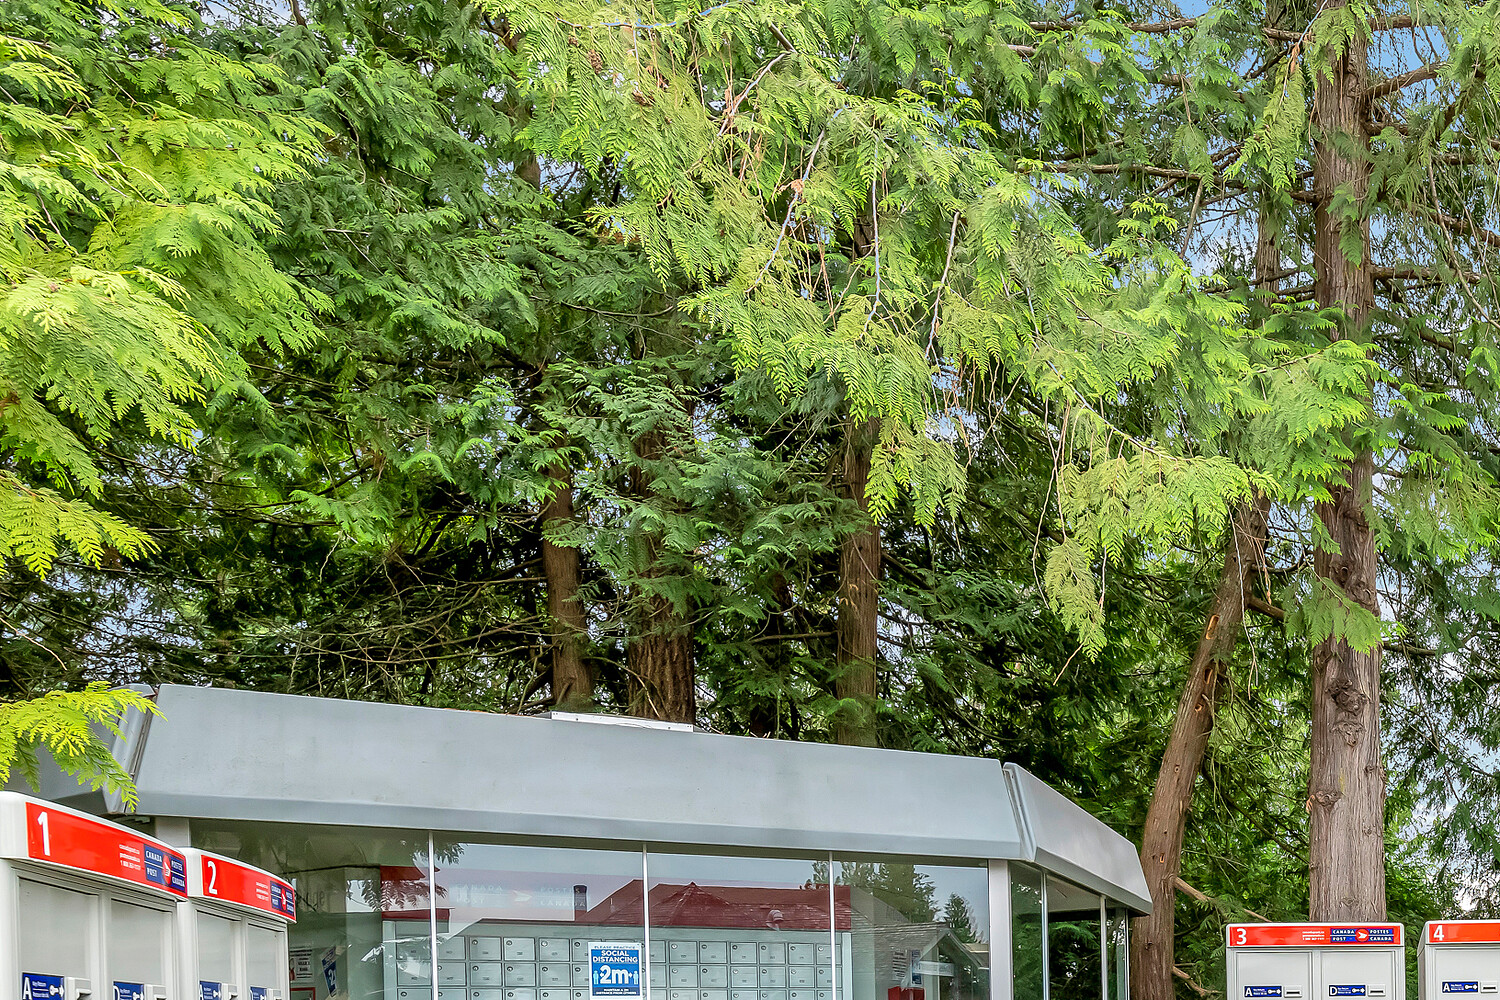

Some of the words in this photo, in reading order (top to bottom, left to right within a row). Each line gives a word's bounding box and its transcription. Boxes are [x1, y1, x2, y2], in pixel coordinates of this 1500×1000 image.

[37, 811, 50, 857] 1
[208, 860, 218, 895] 2
[1236, 928, 1247, 945] 3
[1433, 924, 1445, 941] 4
[600, 964, 629, 985] 2m
[23, 977, 33, 1000] A
[1245, 987, 1253, 997] A
[1329, 986, 1338, 996] D
[1443, 982, 1451, 992] A
